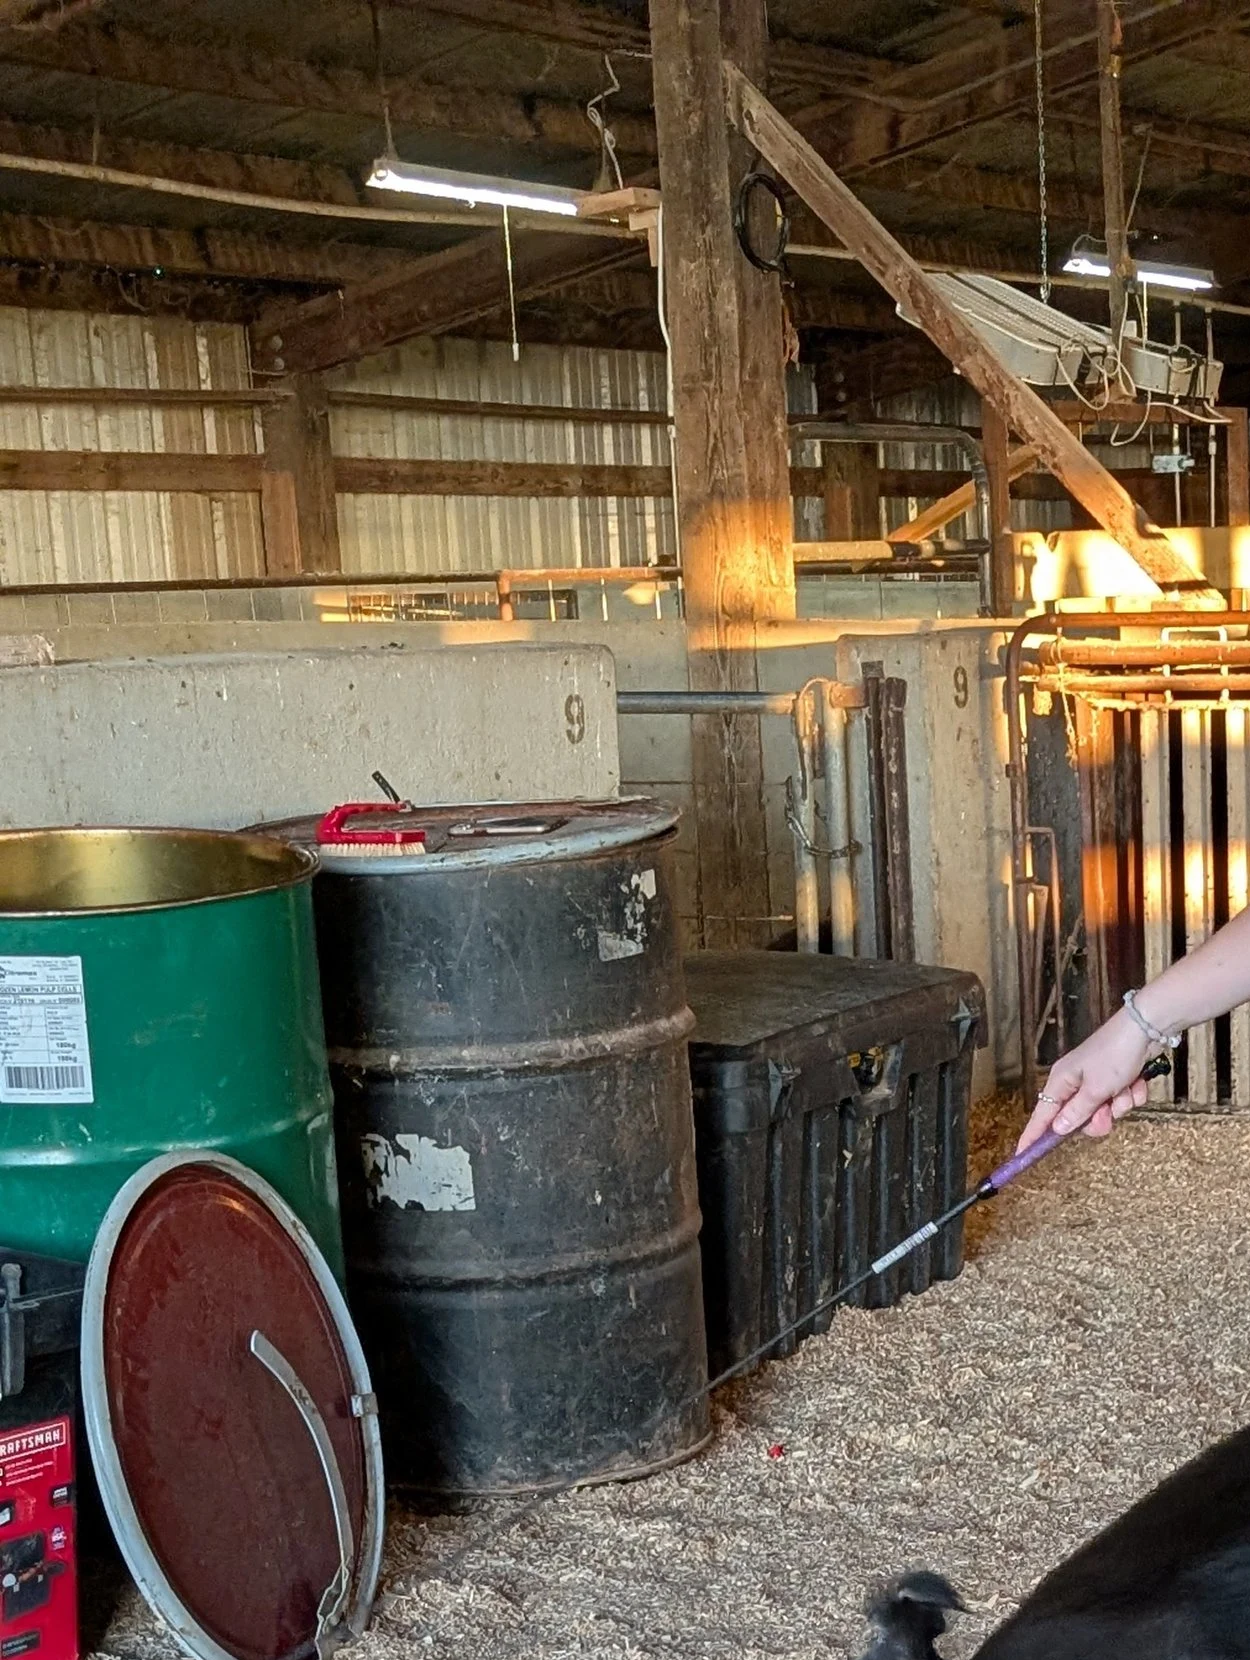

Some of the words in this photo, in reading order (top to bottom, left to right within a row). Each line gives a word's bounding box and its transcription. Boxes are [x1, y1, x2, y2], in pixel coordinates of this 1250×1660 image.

[953, 665, 968, 709] 9
[564, 693, 585, 745] 9
[0, 1428, 61, 1457] RAFTSMAN
